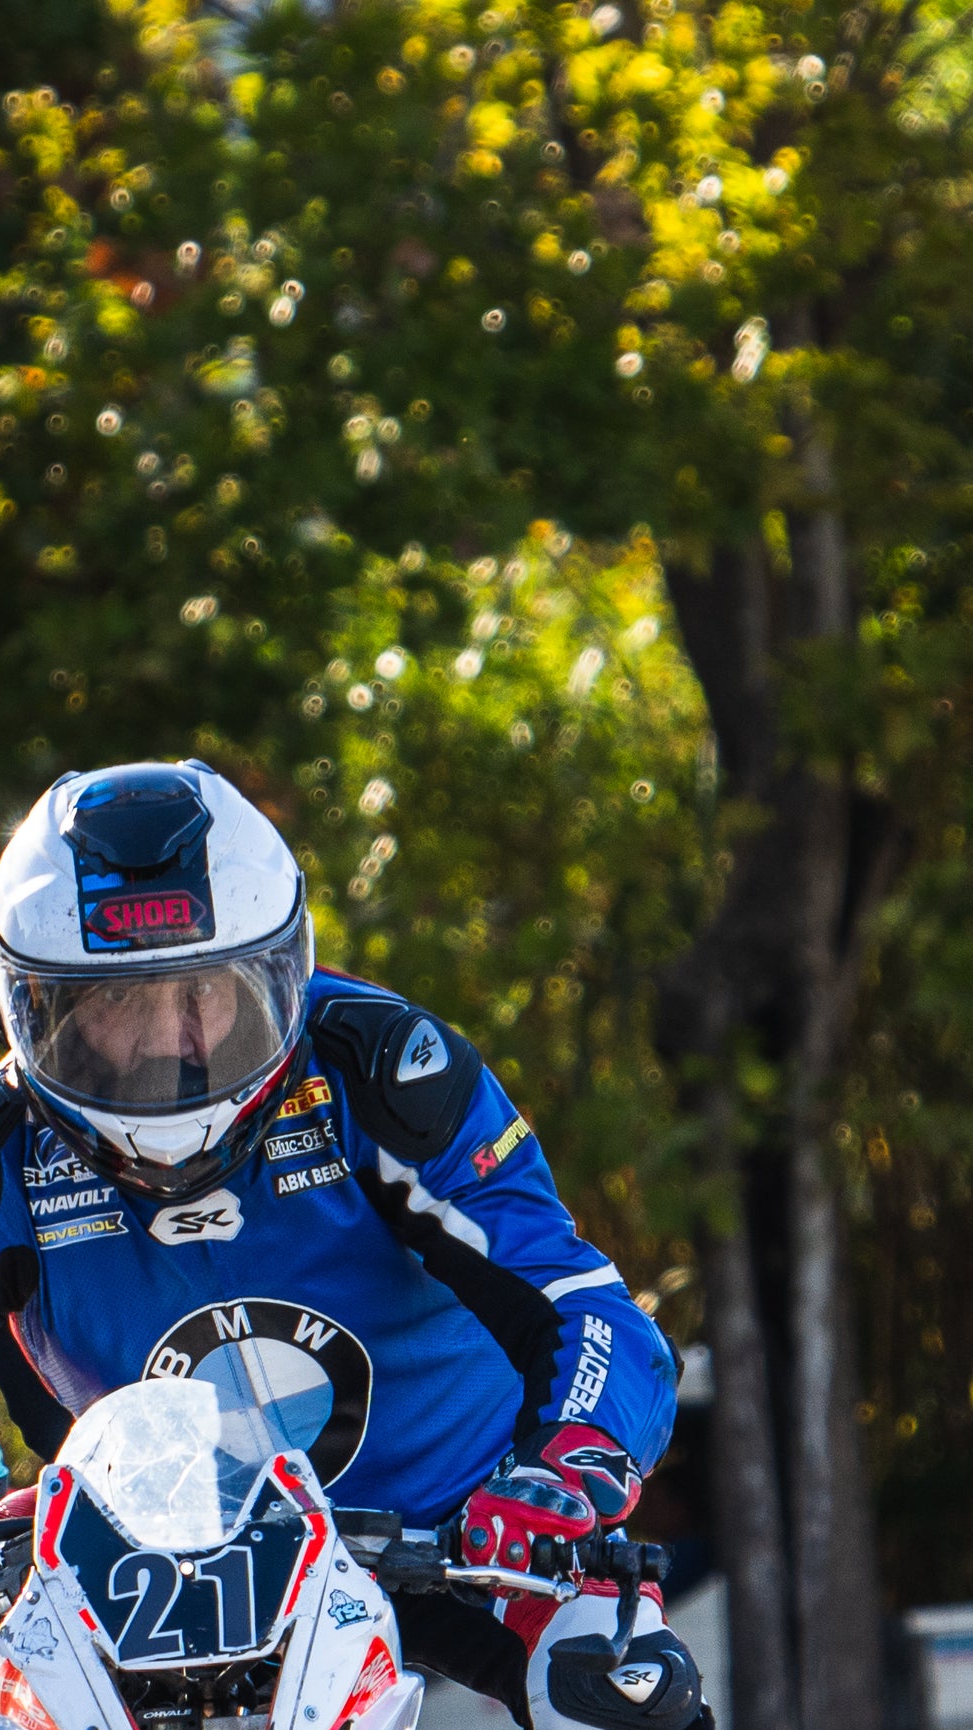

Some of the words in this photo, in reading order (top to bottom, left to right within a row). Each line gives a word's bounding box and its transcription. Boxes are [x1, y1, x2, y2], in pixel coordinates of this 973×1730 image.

[103, 899, 192, 933] SHOEI
[278, 1170, 311, 1194] ABK
[150, 1303, 339, 1379] BMW
[558, 1313, 612, 1423] PEEDYRE
[107, 1544, 257, 1665] 21
